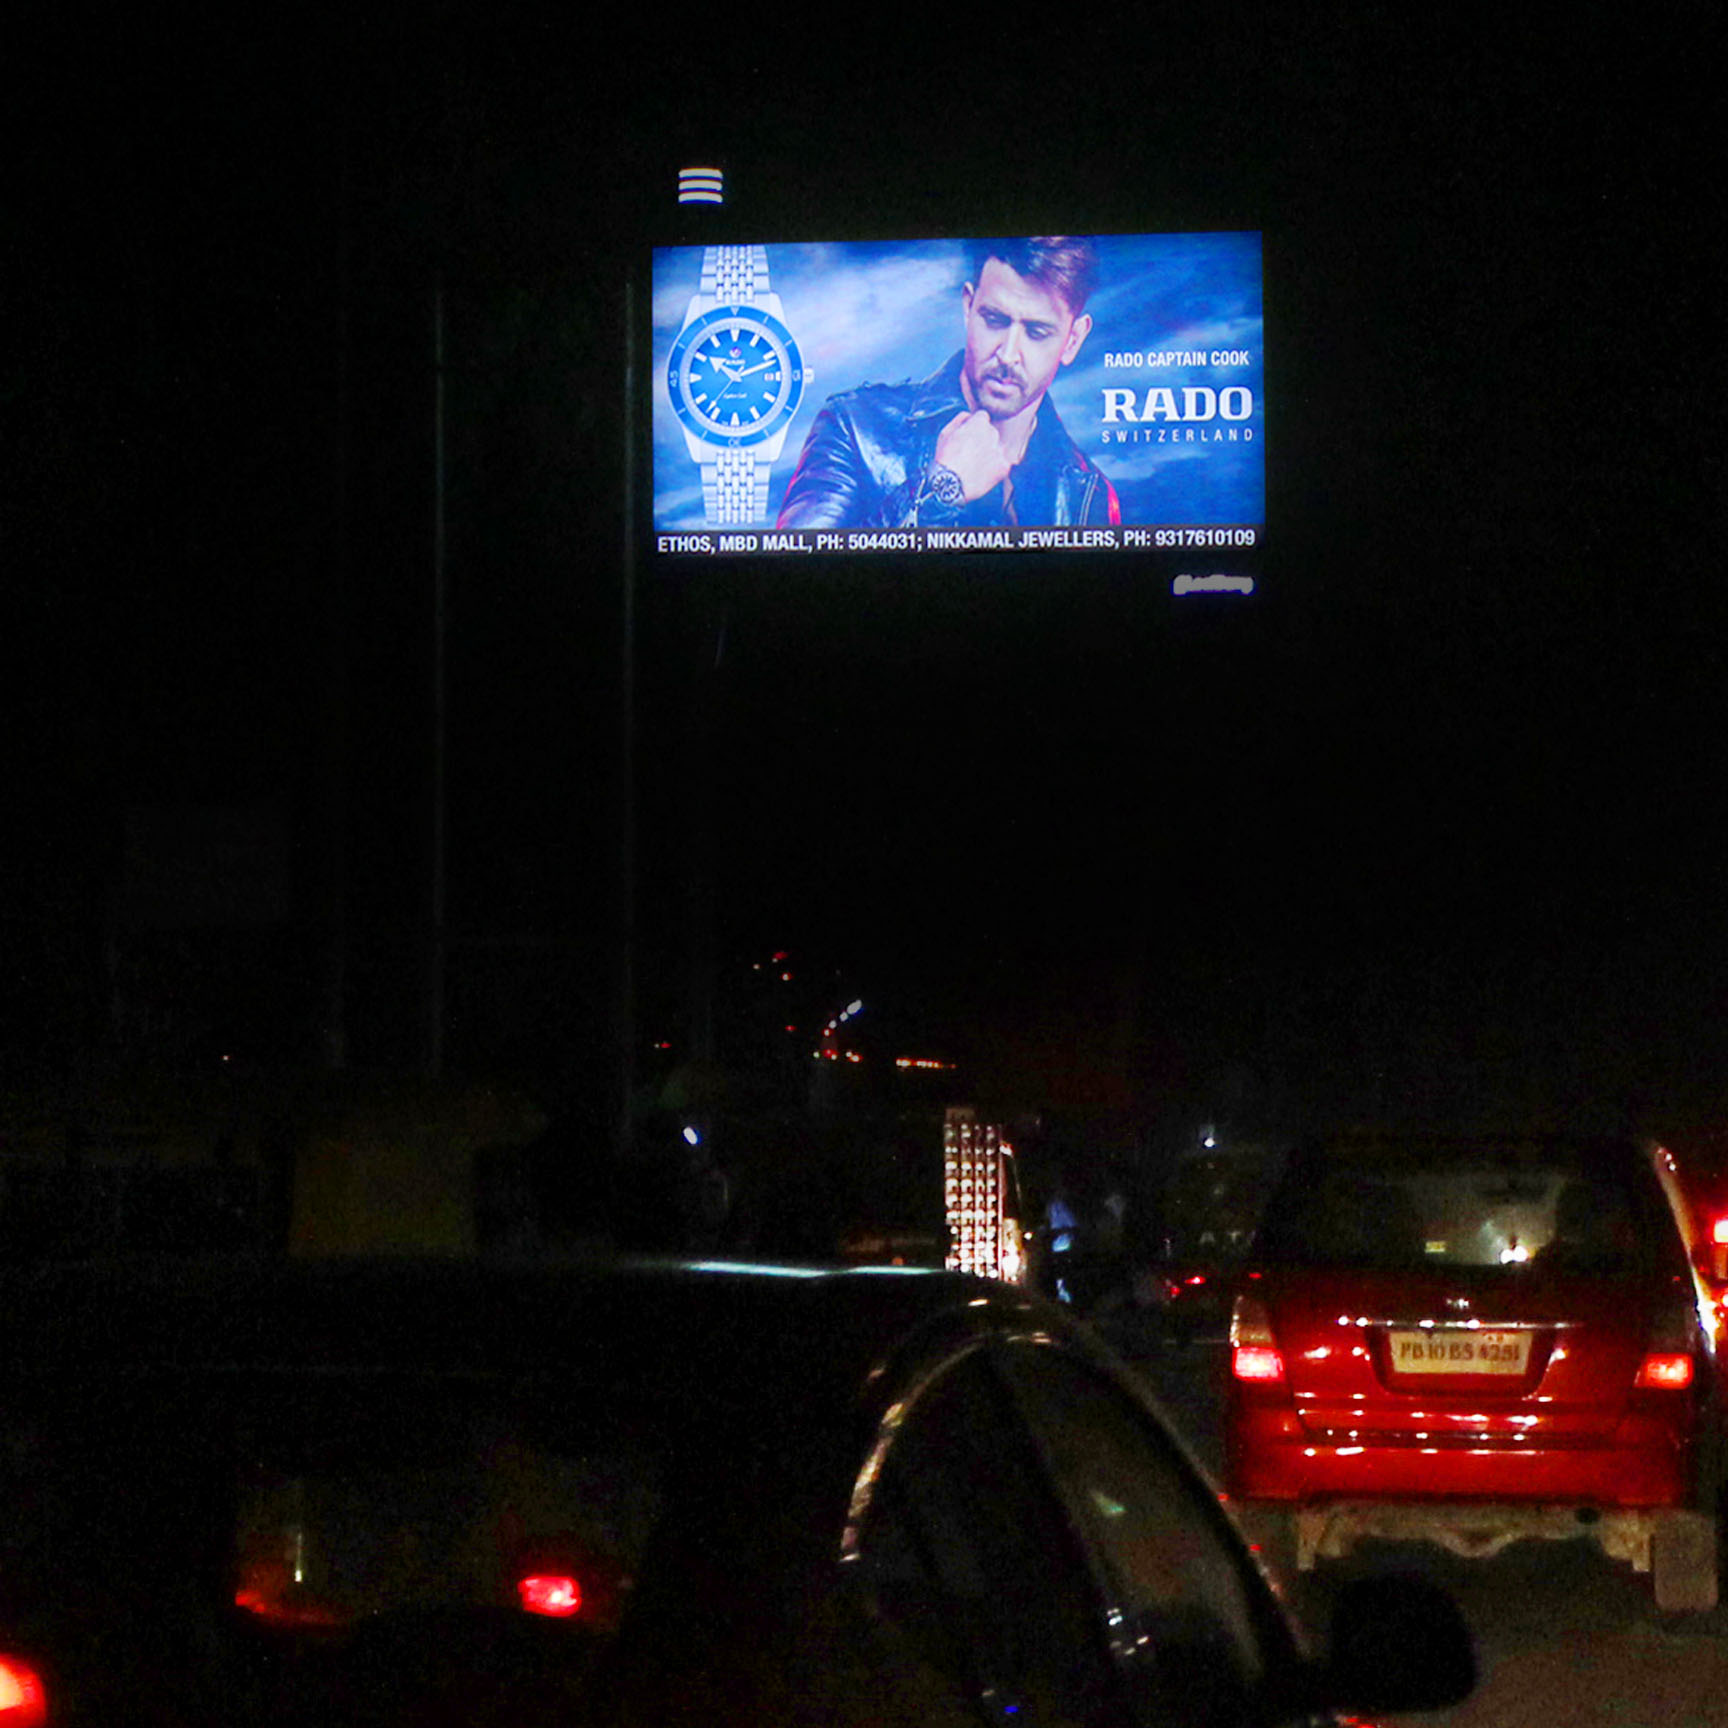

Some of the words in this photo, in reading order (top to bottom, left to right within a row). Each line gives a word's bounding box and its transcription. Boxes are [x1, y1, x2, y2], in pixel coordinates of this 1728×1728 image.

[1104, 351, 1143, 368] RADO
[1147, 351, 1207, 367] CAPTAIN
[1210, 350, 1250, 366] COOK
[1101, 386, 1253, 423] RADO
[1101, 427, 1253, 443] SWITZERLAND
[657, 535, 715, 554] ETHOS,
[719, 535, 758, 552] MBD
[762, 534, 812, 553] MALL,
[817, 533, 844, 551] PH:
[848, 533, 922, 552] 5044031;
[926, 531, 1014, 550] NIKKAMAL
[1018, 530, 1120, 550] JEWELLERS,
[1123, 529, 1152, 547] PH:
[1155, 529, 1256, 547] 9317610109
